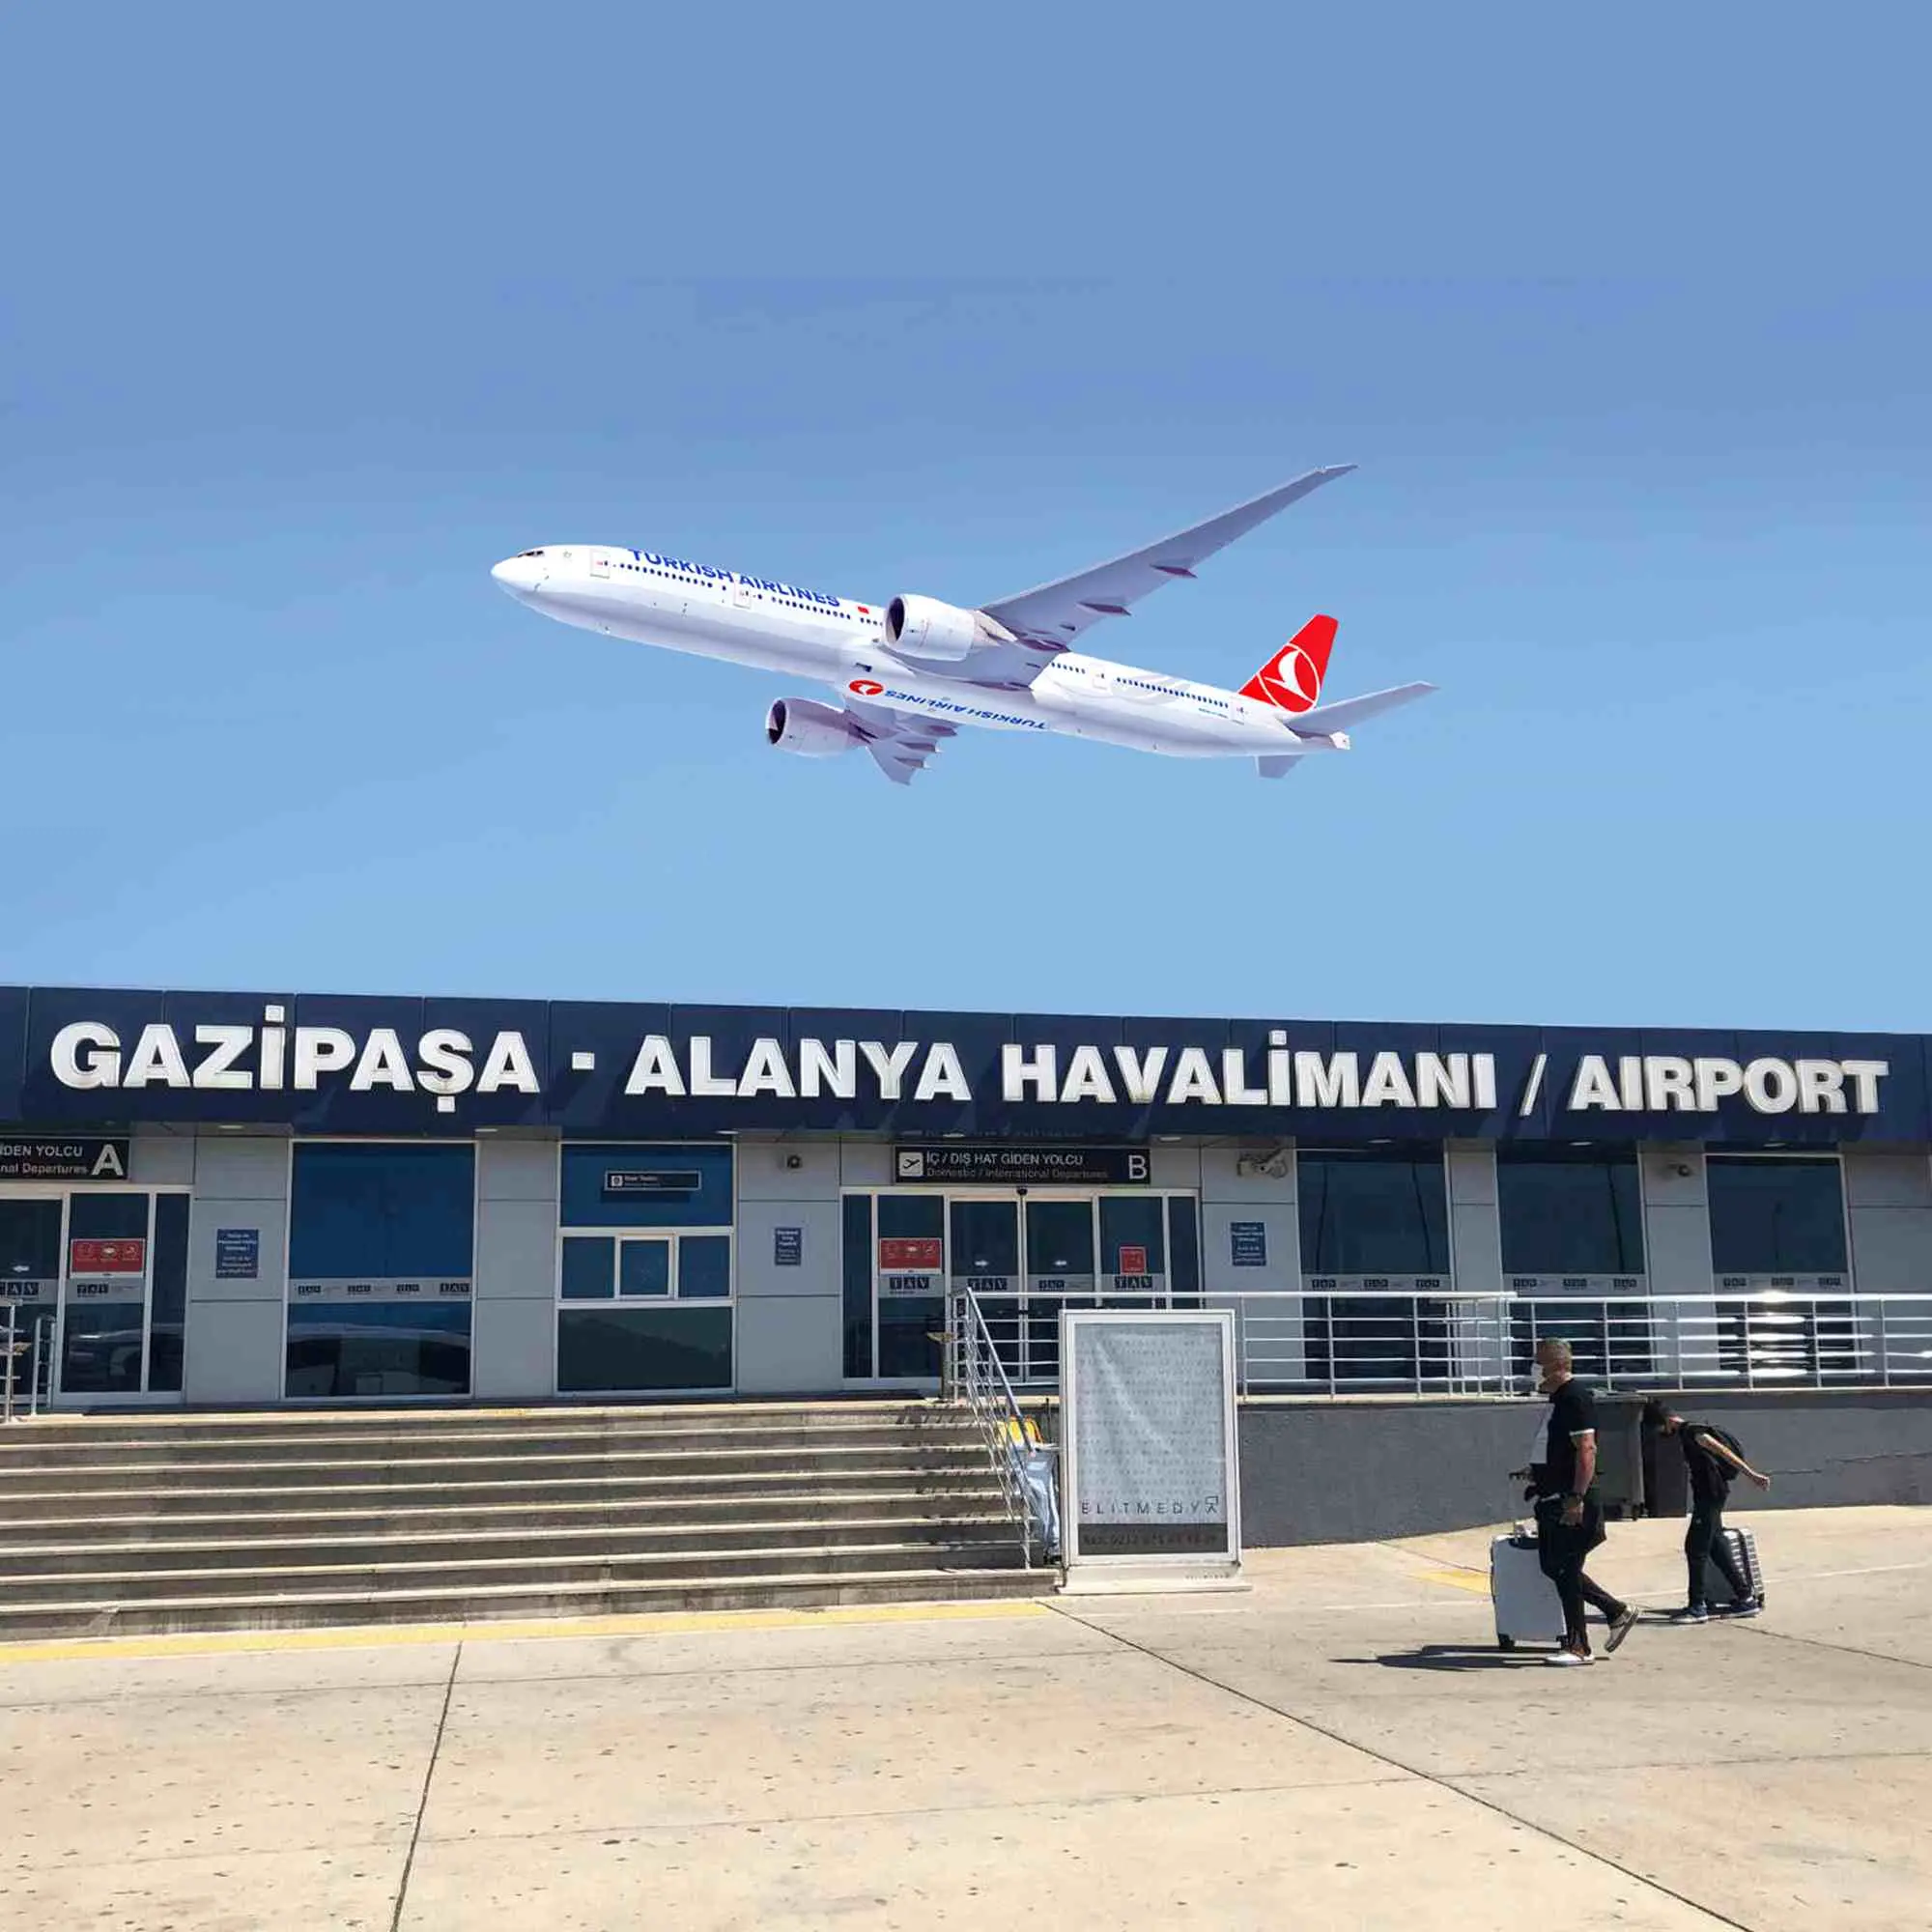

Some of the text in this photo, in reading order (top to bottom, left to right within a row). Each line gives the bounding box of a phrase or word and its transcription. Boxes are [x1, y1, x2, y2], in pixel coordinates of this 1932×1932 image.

[628, 549, 840, 608] TURKISH AIRLINES
[884, 689, 1047, 729] TURKISH AIRLINES
[50, 1005, 540, 1112] GAZİPAŞA
[624, 1036, 972, 1100] ALANYA
[1002, 1031, 1497, 1109] HAVALİMANI
[1520, 1054, 1548, 1116] /
[1569, 1055, 1889, 1114] AIRPORT
[36, 1145, 83, 1157] YOLCU
[91, 1144, 124, 1176] A
[974, 1153, 998, 1165] HAT
[1041, 1153, 1084, 1167] YOLCU
[1128, 1154, 1147, 1179] B
